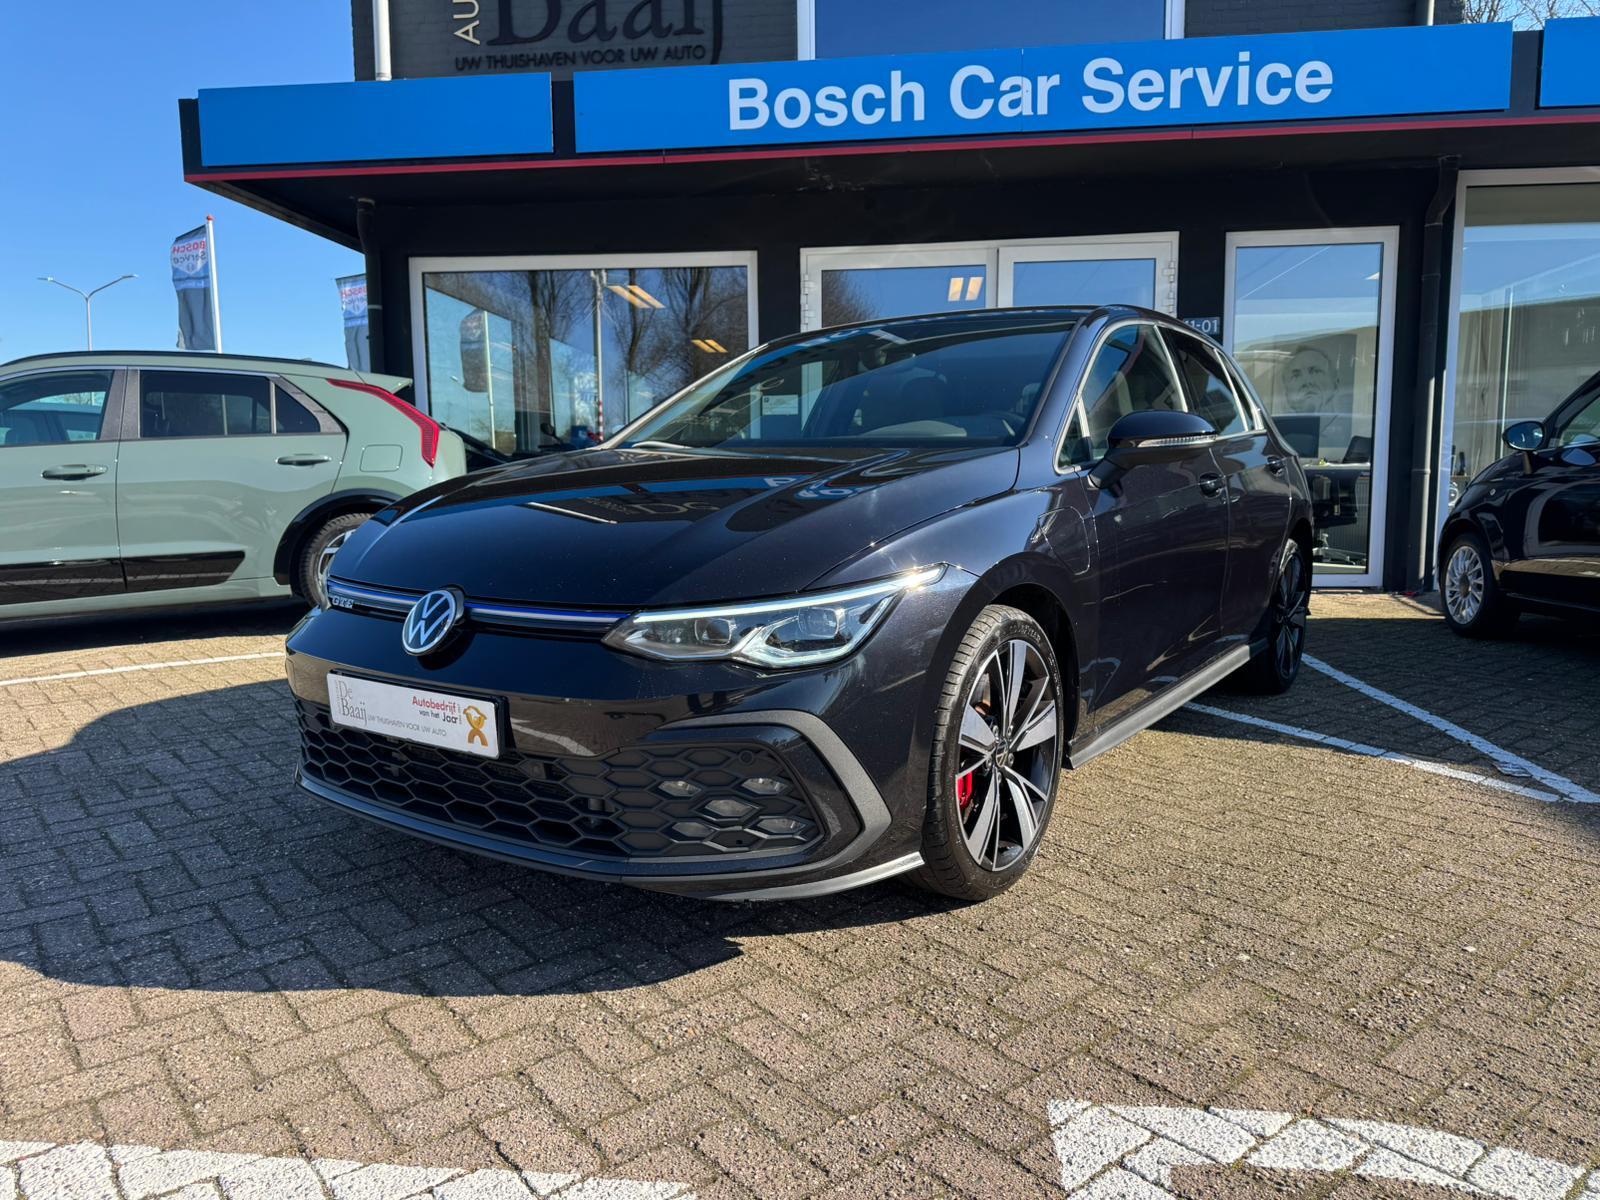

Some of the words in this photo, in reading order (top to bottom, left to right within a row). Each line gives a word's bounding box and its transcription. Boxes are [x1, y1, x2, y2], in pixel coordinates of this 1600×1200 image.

[455, 56, 482, 71] UW
[486, 52, 576, 69] THUISHAVEN
[582, 49, 625, 65] VOOR
[631, 46, 658, 61] UW
[663, 45, 706, 60] AUTO
[728, 70, 926, 131] Bosch
[949, 65, 1060, 118] Car
[1082, 51, 1334, 114] Service
[341, 697, 368, 728] Baaij
[412, 696, 456, 714] Autobedrijf
[442, 712, 458, 724] Jaar
